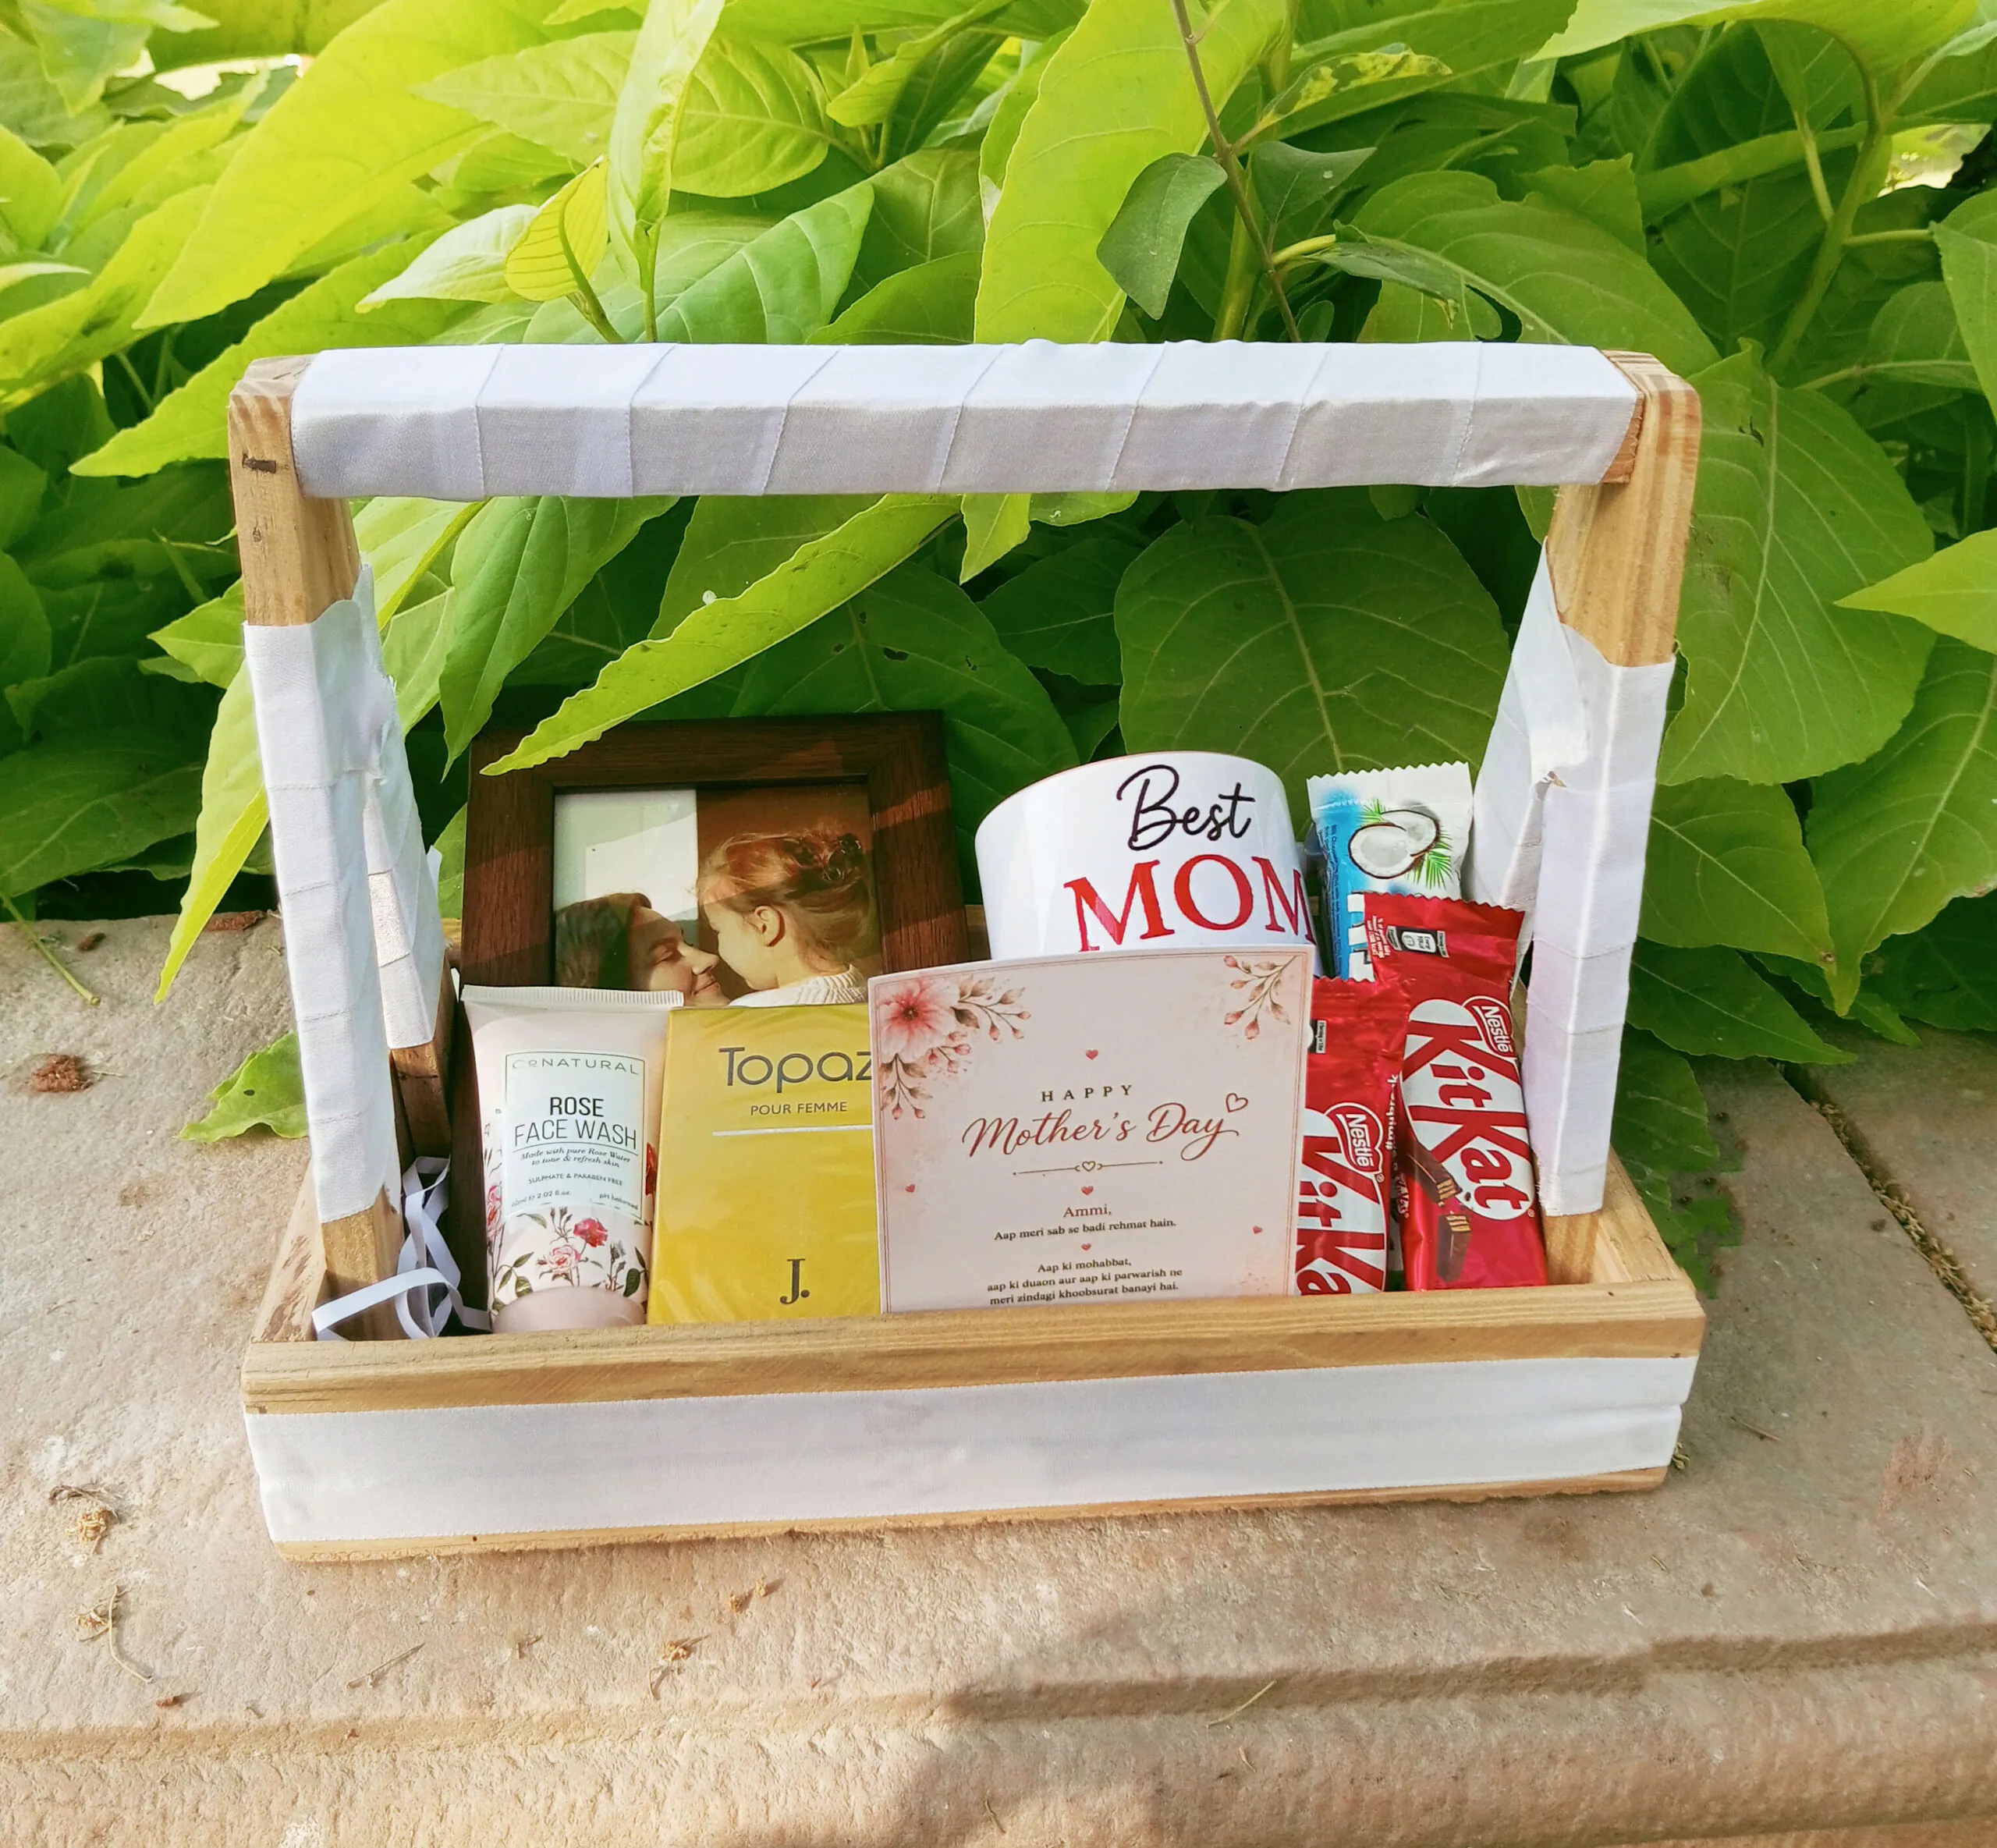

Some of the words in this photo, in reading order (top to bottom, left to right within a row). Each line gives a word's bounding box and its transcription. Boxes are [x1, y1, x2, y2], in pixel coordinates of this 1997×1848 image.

[1116, 764, 1256, 850] Best
[1063, 854, 1316, 952] MOM
[1479, 1004, 1514, 1053] Nestlé
[718, 1047, 872, 1093] Topaz
[549, 1096, 605, 1117] ROSE
[1041, 1084, 1133, 1102] HAPPY
[750, 1103, 792, 1116] POUR
[797, 1101, 848, 1114] FEMME
[1385, 1074, 1398, 1150] #mybrek
[1402, 1020, 1531, 1211] KitKat
[515, 1119, 568, 1147] FACE
[575, 1119, 637, 1150] WASH
[962, 1108, 1137, 1158] Mother's
[1145, 1102, 1240, 1162] Day
[1344, 1113, 1374, 1169] Nestlé
[521, 1150, 544, 1161] Made
[566, 1147, 586, 1156] pure
[588, 1148, 608, 1157] Rose
[609, 1151, 631, 1163] Water
[573, 1155, 601, 1164] refresh
[604, 1158, 620, 1168] skin
[528, 1173, 564, 1184] SULPHATE
[573, 1173, 607, 1182] PARABEN
[1063, 1204, 1112, 1218] Ammi,
[1296, 1136, 1385, 1296] KitKa
[994, 1231, 1016, 1241] Aap
[1020, 1228, 1044, 1238] meri
[1047, 1225, 1065, 1235] sab
[1083, 1222, 1105, 1233] badi
[1108, 1221, 1147, 1231] rehmat
[1150, 1218, 1176, 1228] hain.
[988, 1282, 1006, 1292] aap
[1009, 1280, 1019, 1289] ki
[1022, 1279, 1055, 1289] duaon
[1059, 1275, 1076, 1284] aur
[1080, 1275, 1098, 1284] aap
[1101, 1272, 1111, 1282] ki
[1114, 1268, 1166, 1282] parwarish
[1038, 1264, 1059, 1273] Aap
[1062, 1261, 1072, 1271] ki
[779, 1257, 811, 1305] J.
[990, 1295, 1014, 1305] meri
[1017, 1290, 1055, 1303] zindagi
[1059, 1286, 1118, 1299] khoobsurat
[1122, 1282, 1156, 1293] banayi
[1159, 1281, 1179, 1291] hai.
